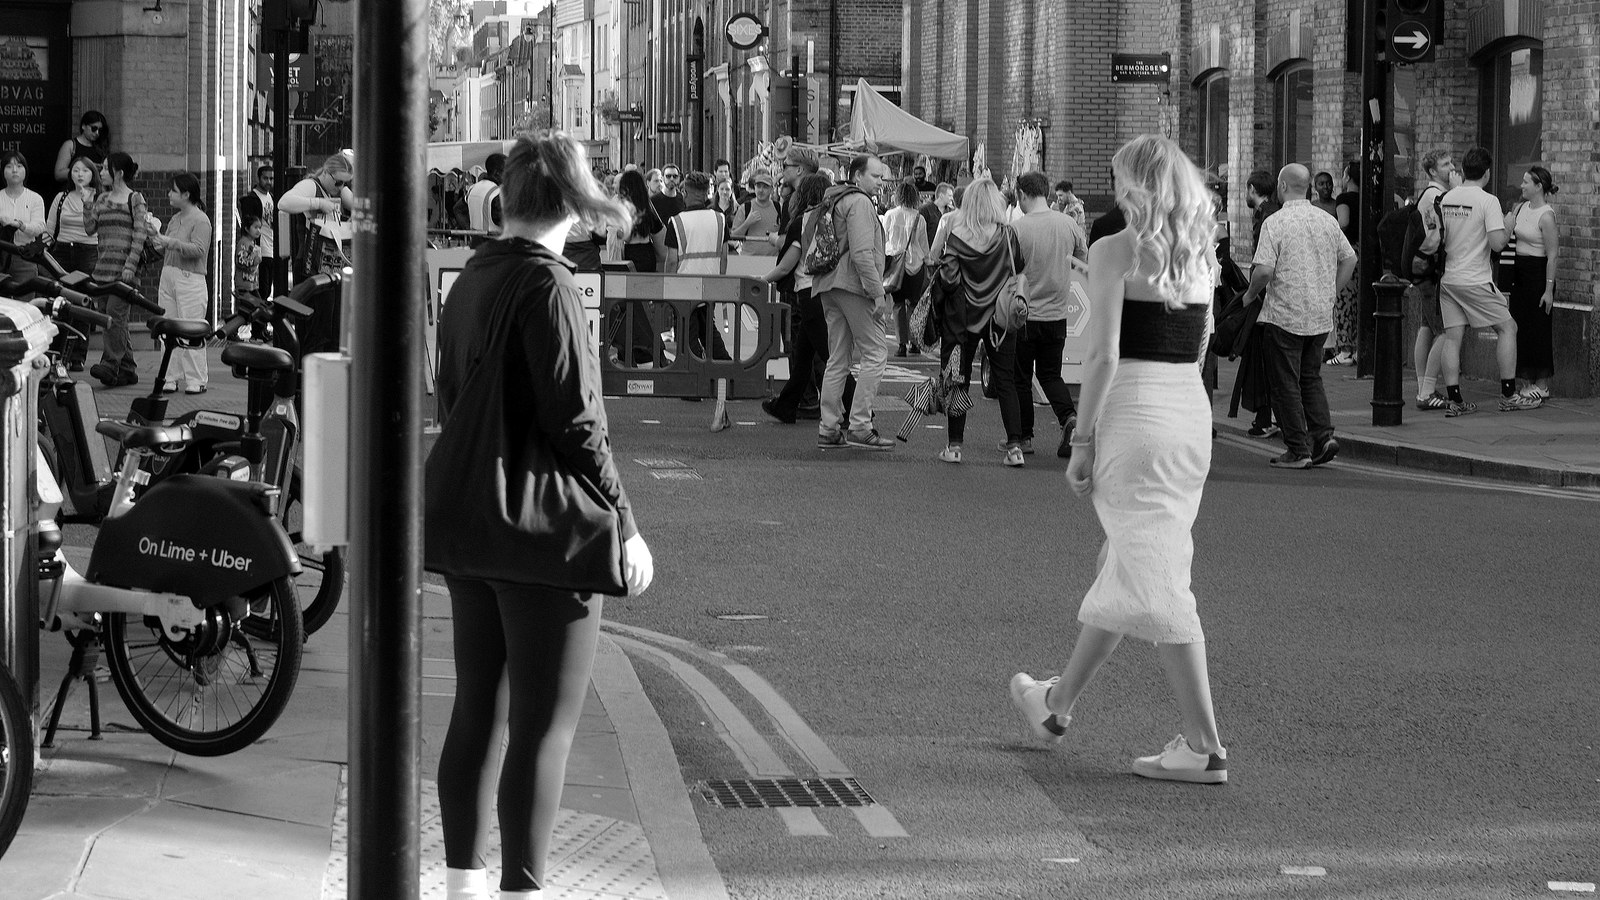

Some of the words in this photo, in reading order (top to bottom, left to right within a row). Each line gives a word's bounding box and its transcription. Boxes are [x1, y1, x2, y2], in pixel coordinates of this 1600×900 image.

[728, 23, 762, 36] SIXES
[689, 61, 698, 99] woolyard
[12, 123, 46, 134] SPACE
[2, 141, 21, 152] LET
[139, 536, 158, 556] On
[159, 540, 195, 562] Lime
[199, 549, 208, 561] +
[211, 548, 252, 572] Uber
